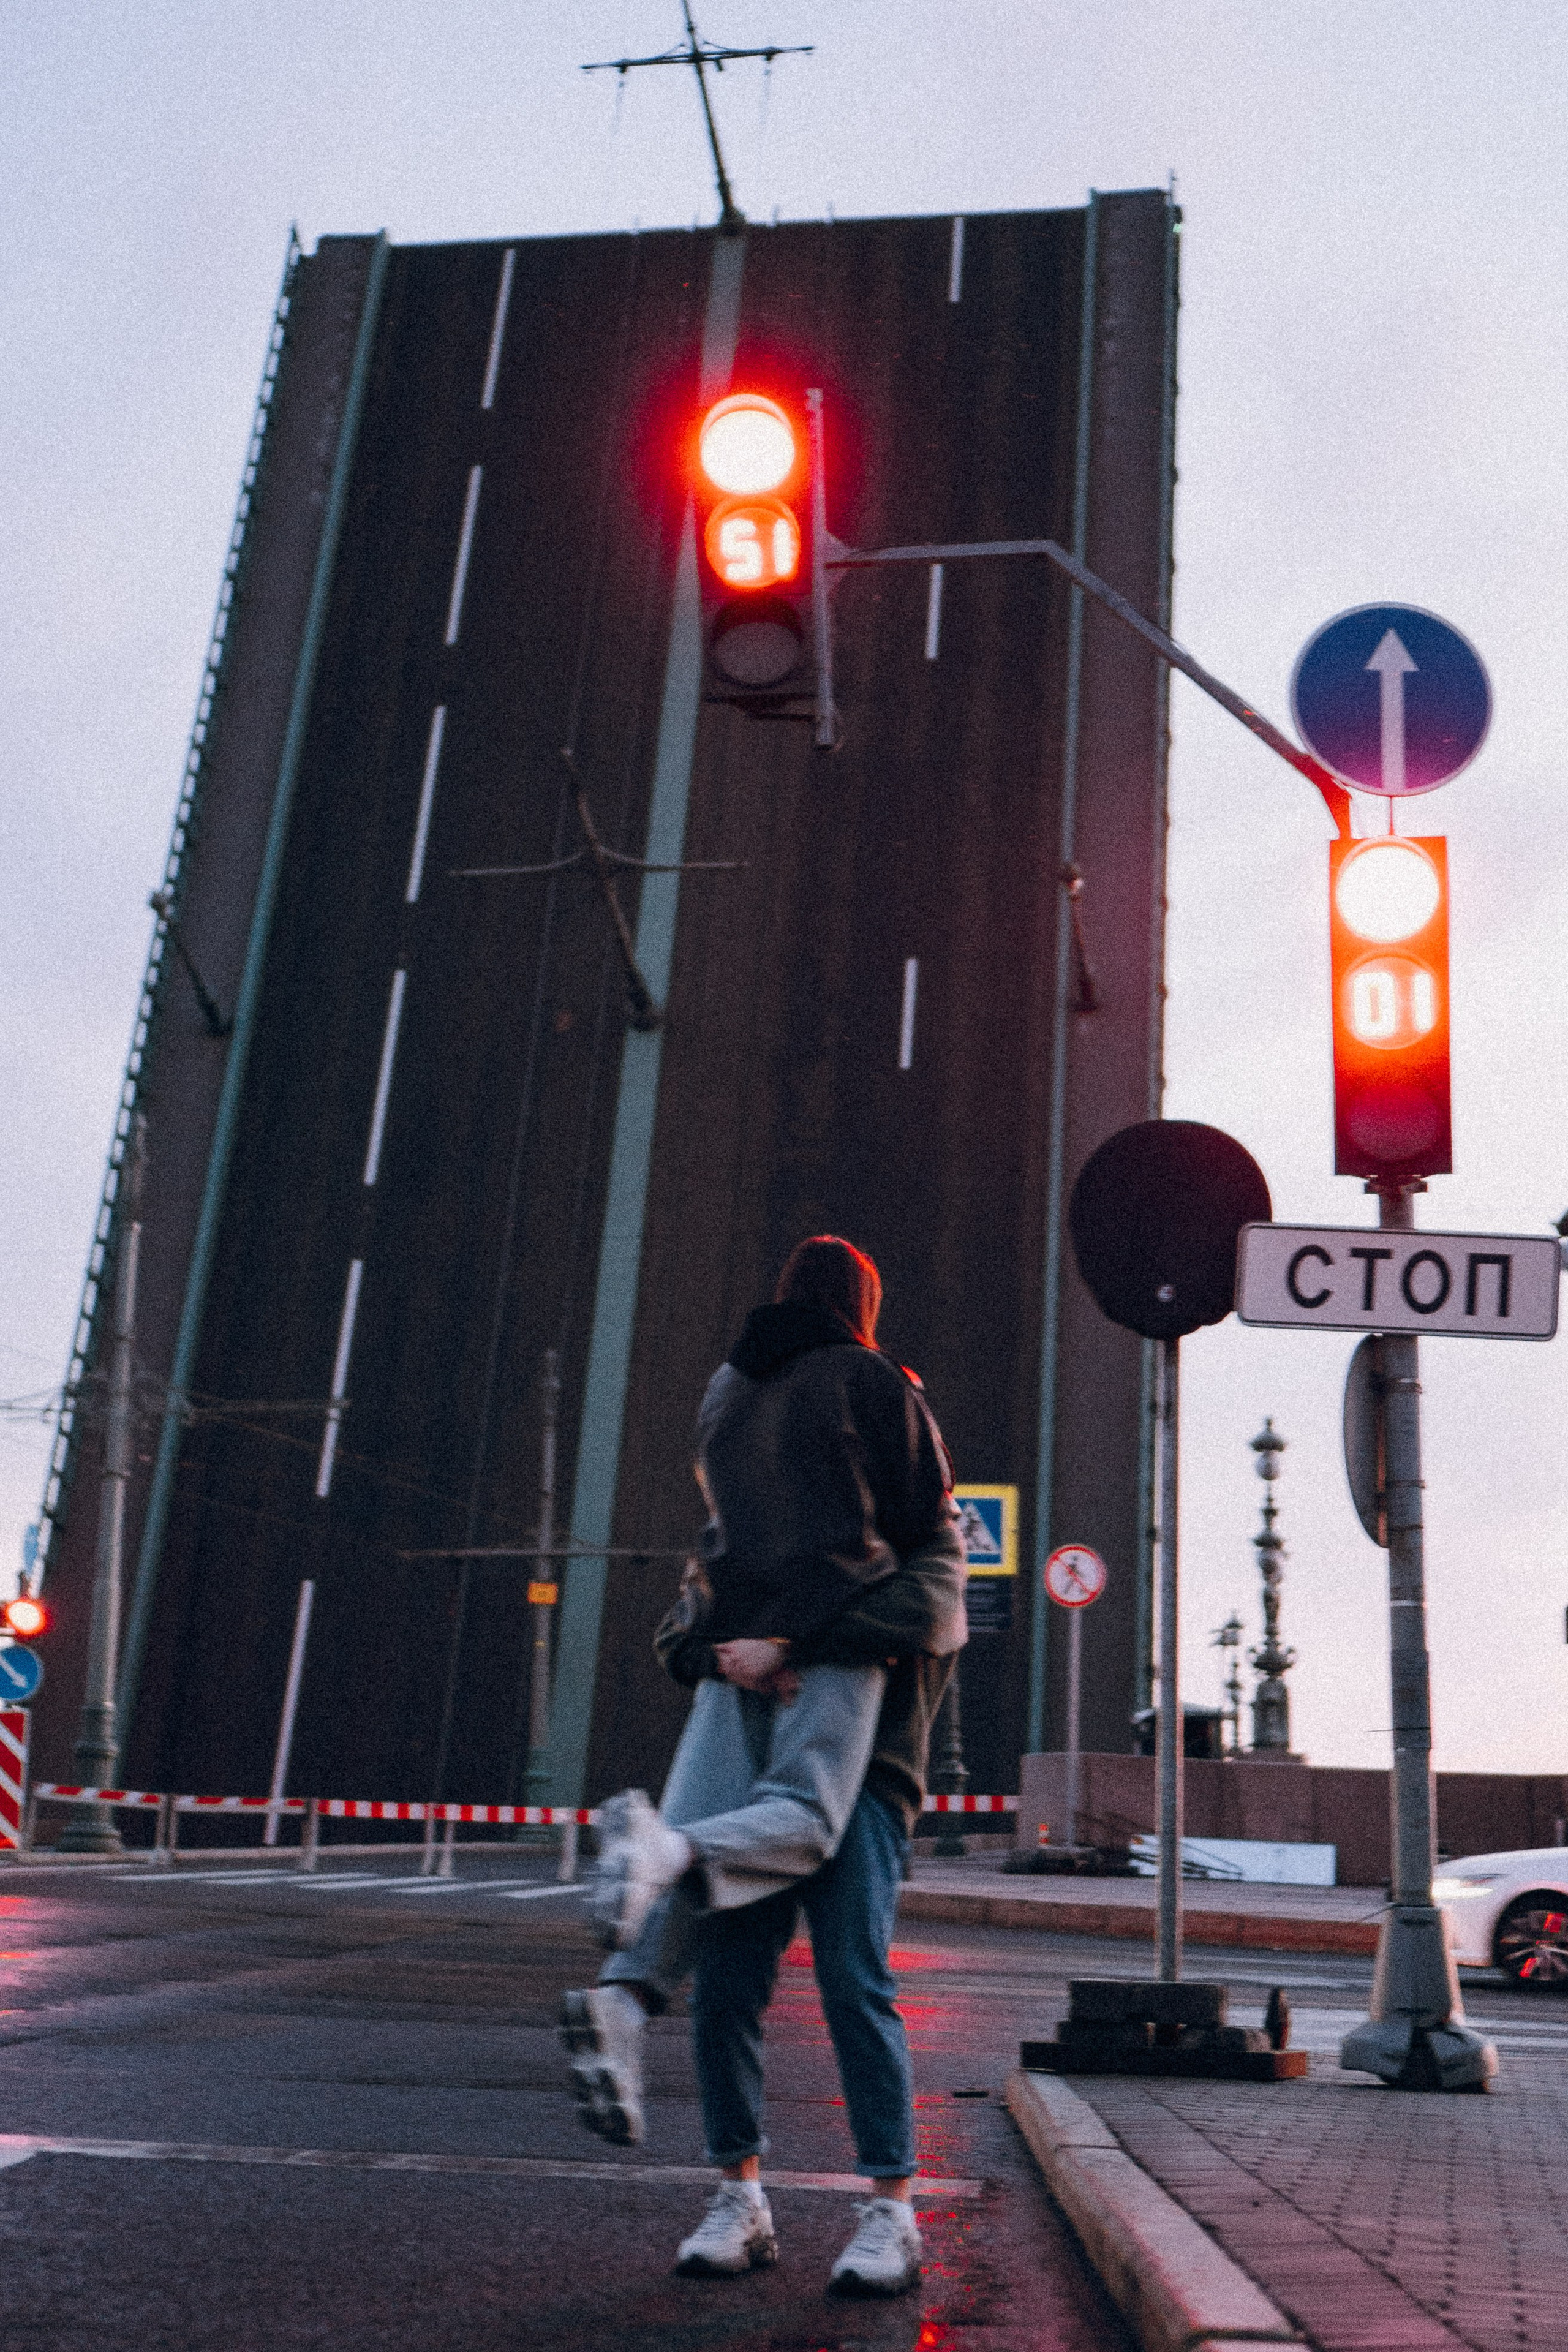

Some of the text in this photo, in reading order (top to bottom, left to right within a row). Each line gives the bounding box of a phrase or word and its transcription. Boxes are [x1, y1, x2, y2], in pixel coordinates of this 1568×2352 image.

[720, 519, 793, 581] 51
[1353, 971, 1433, 1036] 01
[1287, 1244, 1512, 1317] СТОП
